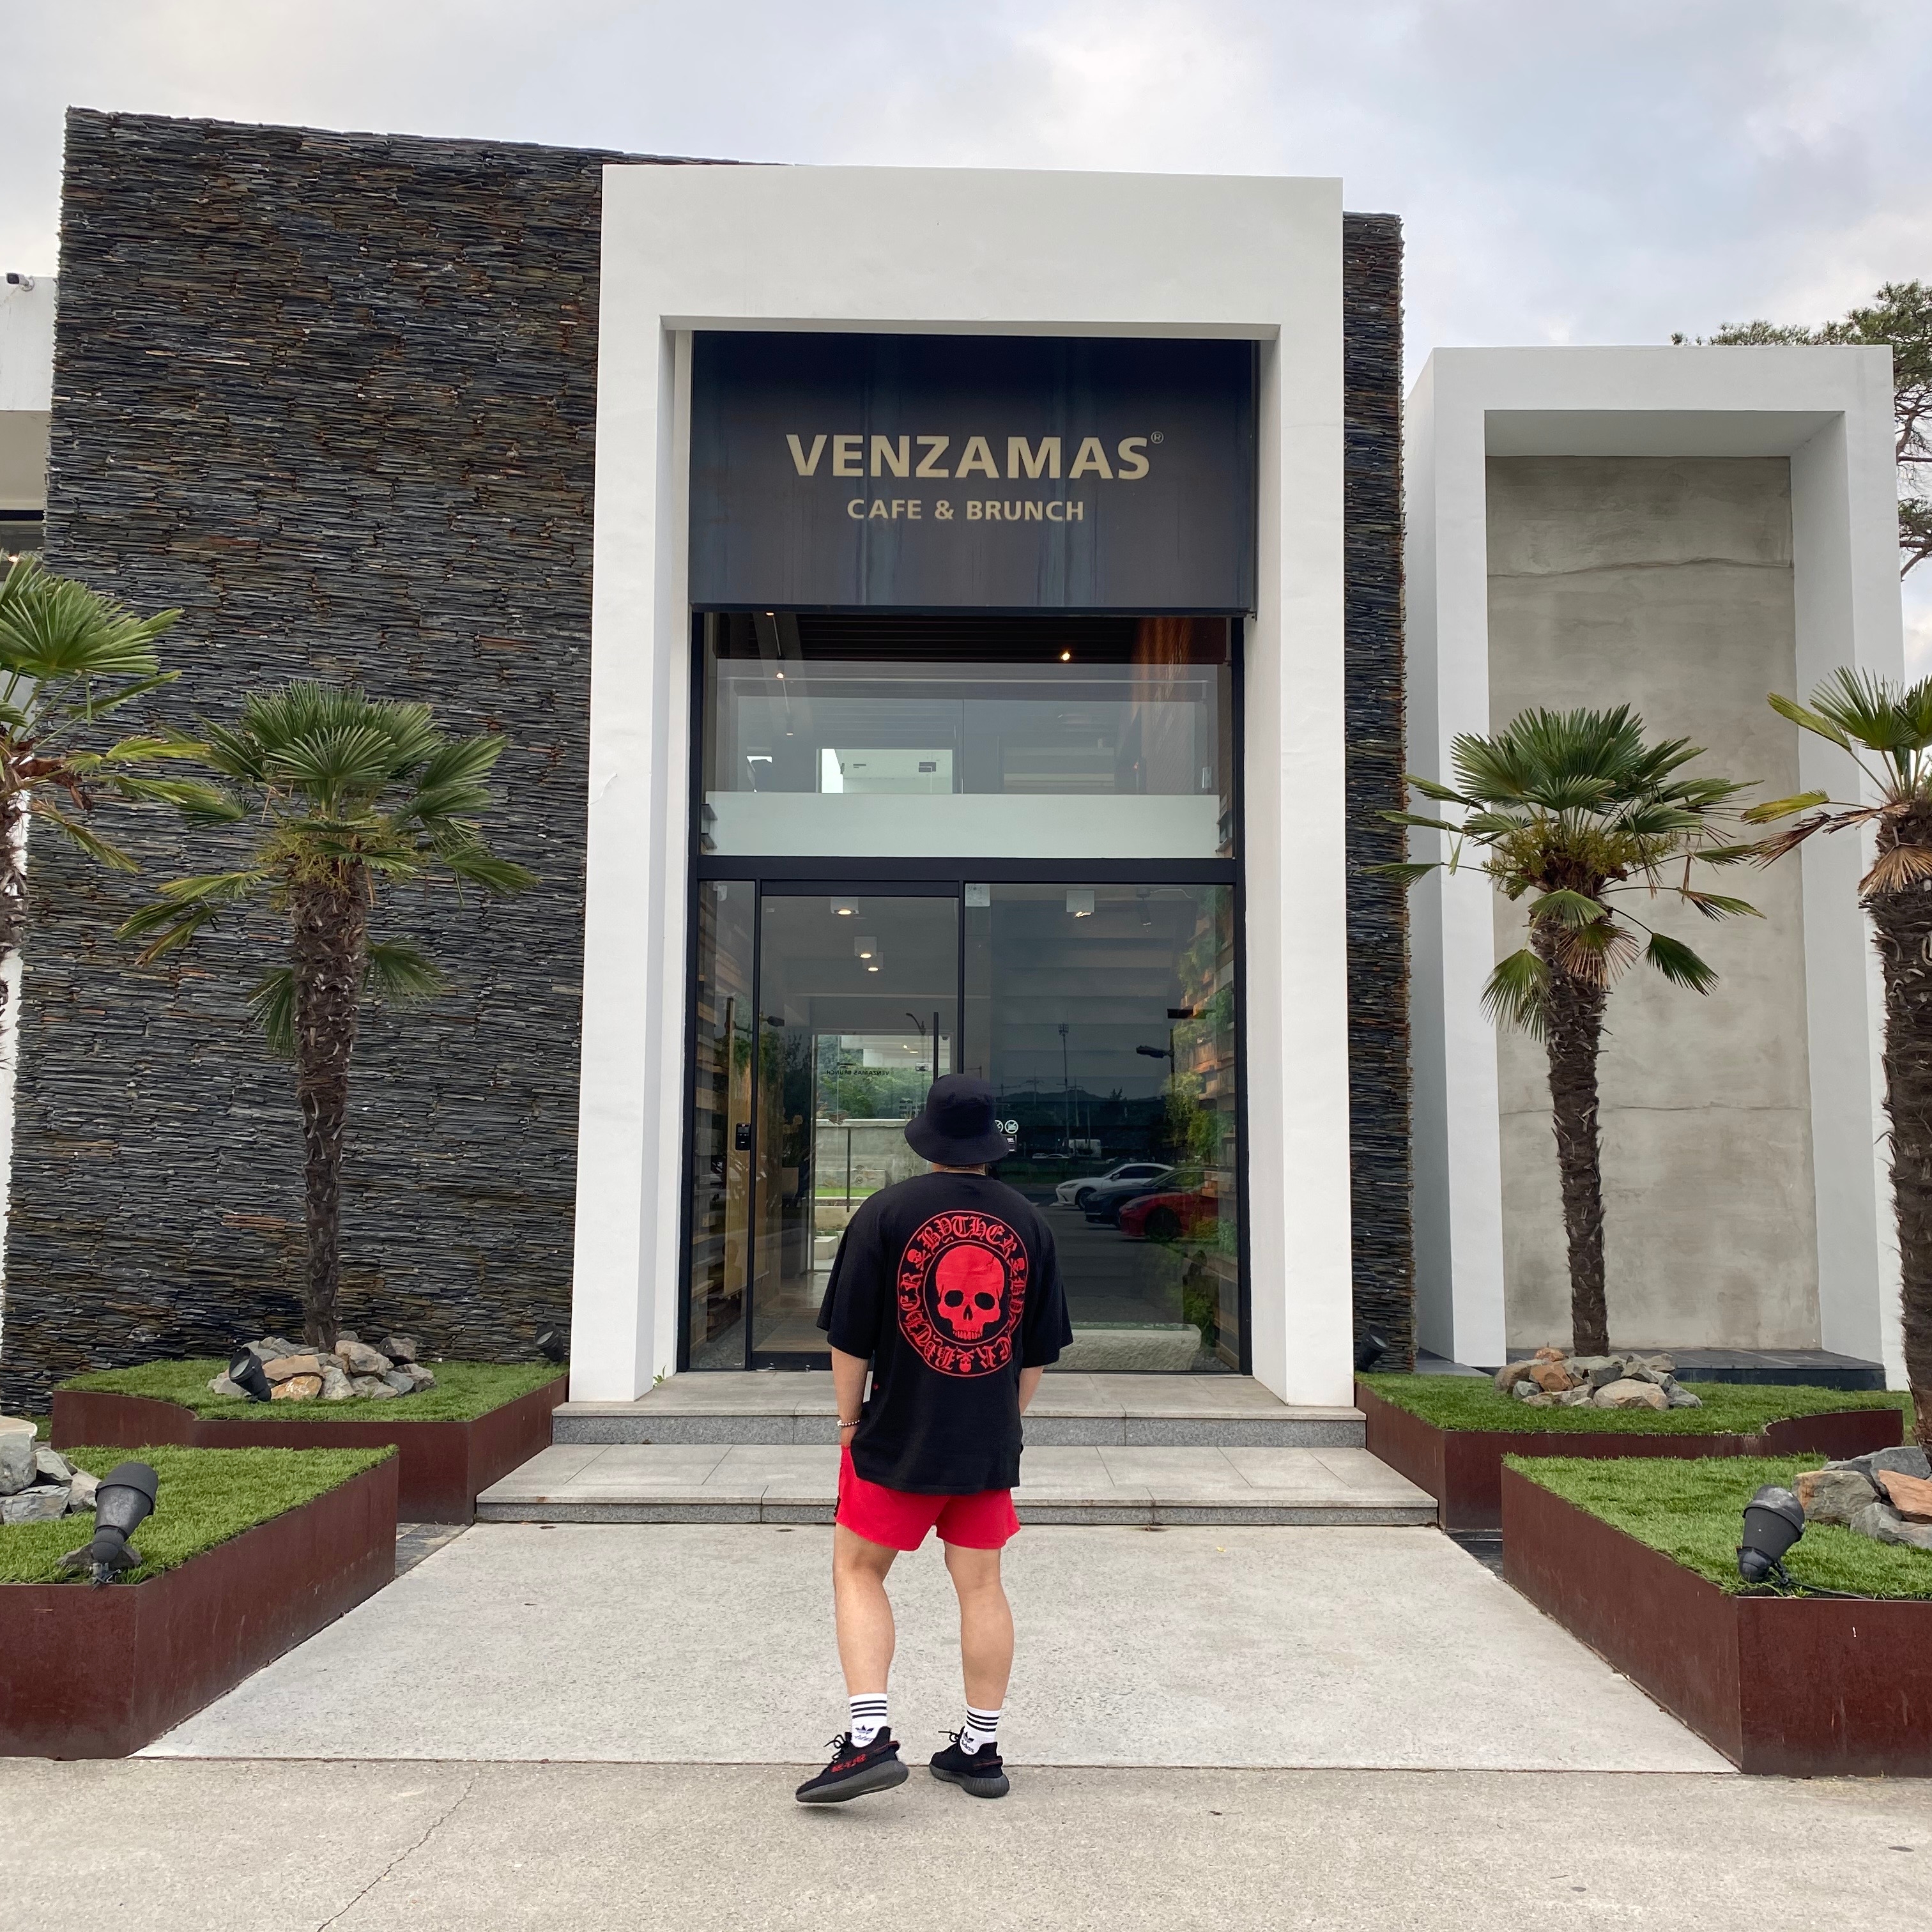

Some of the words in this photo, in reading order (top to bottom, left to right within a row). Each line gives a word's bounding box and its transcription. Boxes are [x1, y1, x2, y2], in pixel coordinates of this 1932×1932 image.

[847, 499, 922, 520] CAFE
[935, 500, 954, 521] &
[967, 501, 1085, 522] BRUNCH
